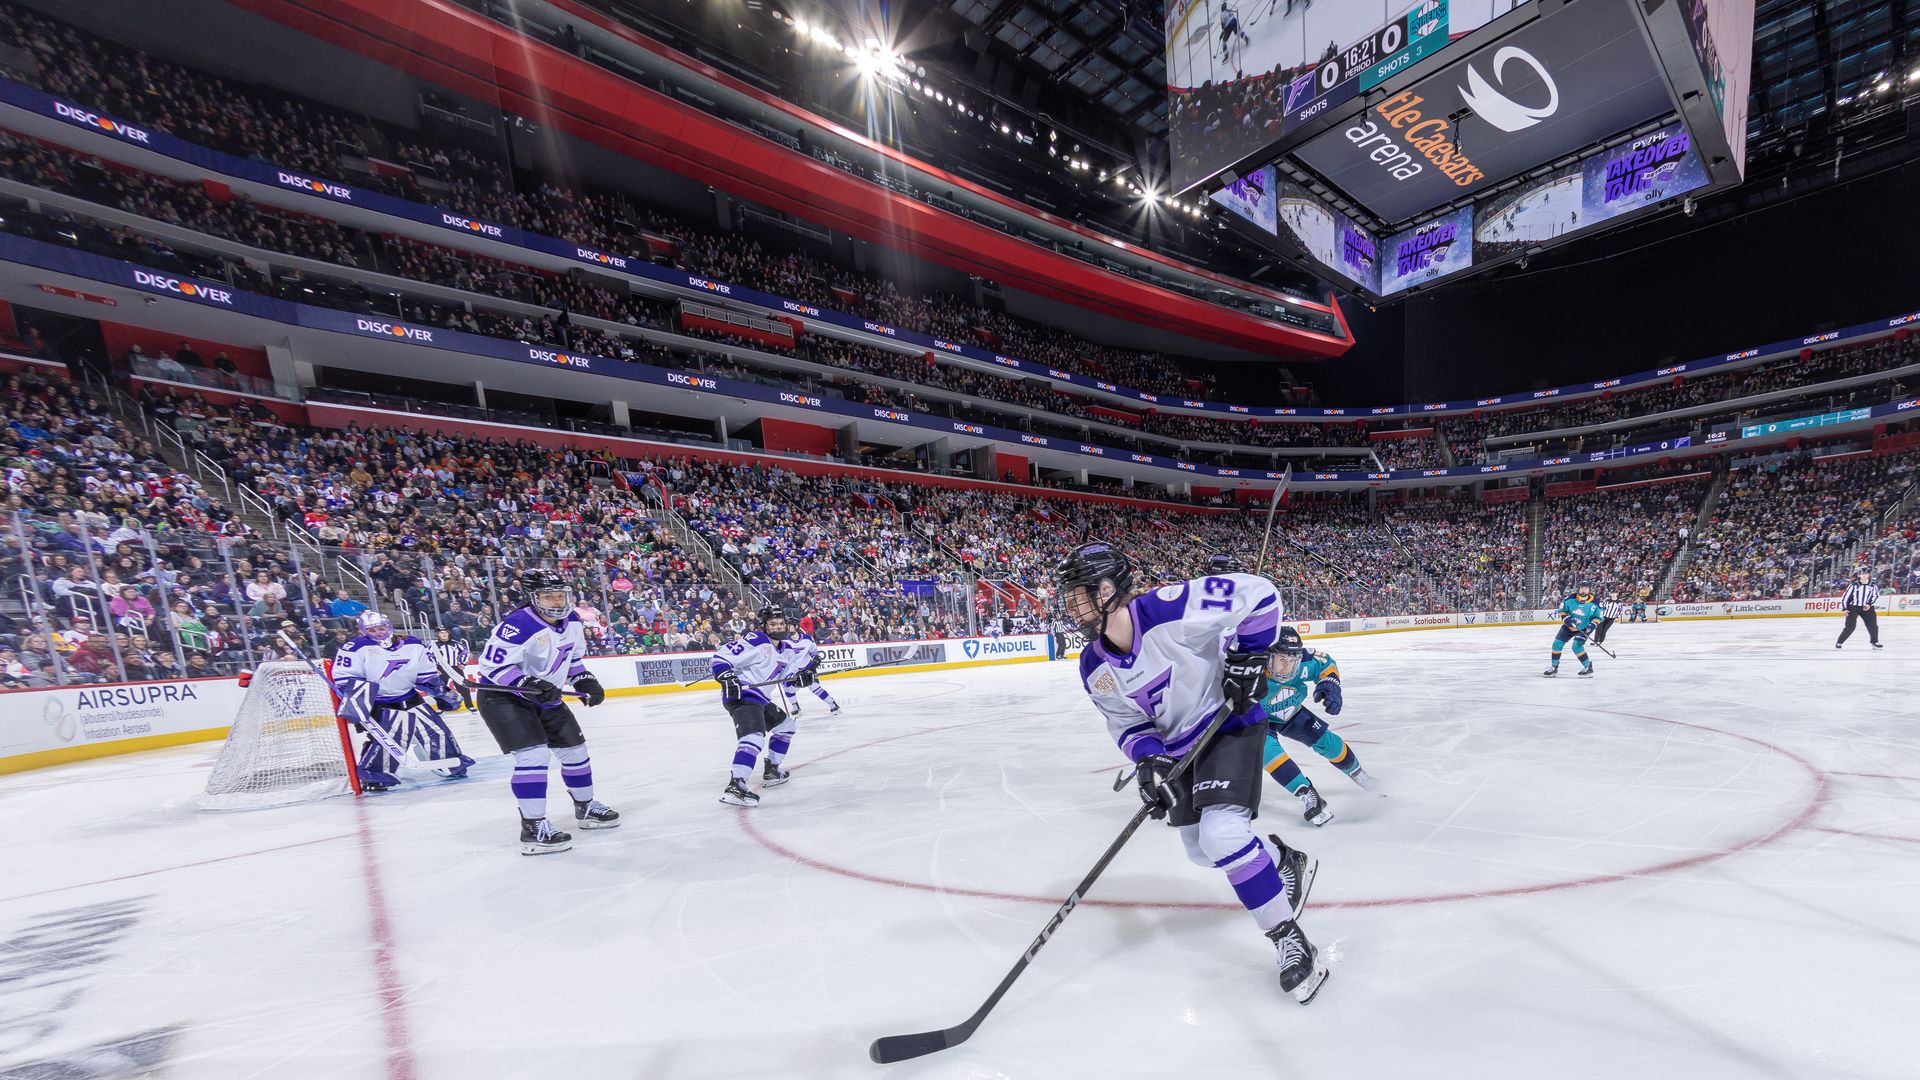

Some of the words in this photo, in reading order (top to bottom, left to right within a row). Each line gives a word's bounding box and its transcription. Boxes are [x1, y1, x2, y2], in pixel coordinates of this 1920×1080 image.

[1343, 36, 1377, 71] 16:21
[1381, 24, 1401, 54] 0
[1345, 61, 1373, 79] PERIOD
[1378, 53, 1410, 78] SHOTS
[1416, 46, 1422, 56] 3
[1321, 61, 1339, 89] 0
[1300, 99, 1327, 121] SHOTS
[55, 102, 149, 143] DISCOVER
[1376, 91, 1424, 129] tle
[1405, 119, 1486, 187] Caesars
[1632, 131, 1669, 150] PWHL
[1345, 121, 1422, 181] arena
[1606, 133, 1690, 179] TAKEOVER
[278, 172, 351, 200] DISCOVER
[1604, 167, 1654, 203] TOUR
[1645, 189, 1664, 200] ally
[442, 214, 502, 237] DISCOVER
[1415, 220, 1441, 236] PWHL
[1398, 223, 1457, 258] TAKEOVER
[577, 248, 626, 268] DISCOVER
[1397, 249, 1433, 277] TOUR
[1426, 268, 1439, 278] ally
[134, 270, 232, 305] DISCOVER
[689, 277, 730, 294] DISCOVER
[784, 301, 819, 317] DISCOVER
[1889, 312, 1920, 326] DISCOVE
[357, 319, 432, 342] DISCOVER
[864, 321, 895, 336] DISCOVER
[1803, 332, 1840, 344] DISCOVER
[529, 349, 590, 368] DISCOVER
[1727, 349, 1758, 360] DISCOVER
[1657, 365, 1687, 375] DISCOVER
[667, 373, 717, 390] DISCOVER
[780, 392, 821, 407] DISCOVER
[875, 409, 909, 421] DISCOVER
[954, 423, 983, 434] DISCOVER
[1201, 576, 1235, 612] 13
[1675, 604, 1714, 613] Gallagher
[1735, 604, 1758, 613] Little
[1759, 603, 1782, 612] Caesars
[1805, 599, 1841, 612] meijer
[1414, 616, 1450, 626] Scotiabank
[983, 641, 1036, 654] FANDUEL
[1065, 637, 1090, 649] DISC
[335, 655, 352, 668] 29
[485, 644, 508, 664] 16
[819, 648, 855, 660] ORITY
[873, 647, 902, 665] ally
[641, 660, 673, 670] WOODY
[681, 658, 711, 668] WOODY
[682, 666, 711, 675] CREEK
[642, 668, 675, 678] CREEK
[643, 676, 676, 685] DISTILLERS
[1300, 666, 1309, 679] A
[77, 684, 197, 710] AIRSUPRA
[84, 725, 120, 740] Inhalation
[123, 721, 151, 735] Aerosol
[1192, 780, 1230, 794] CCM
